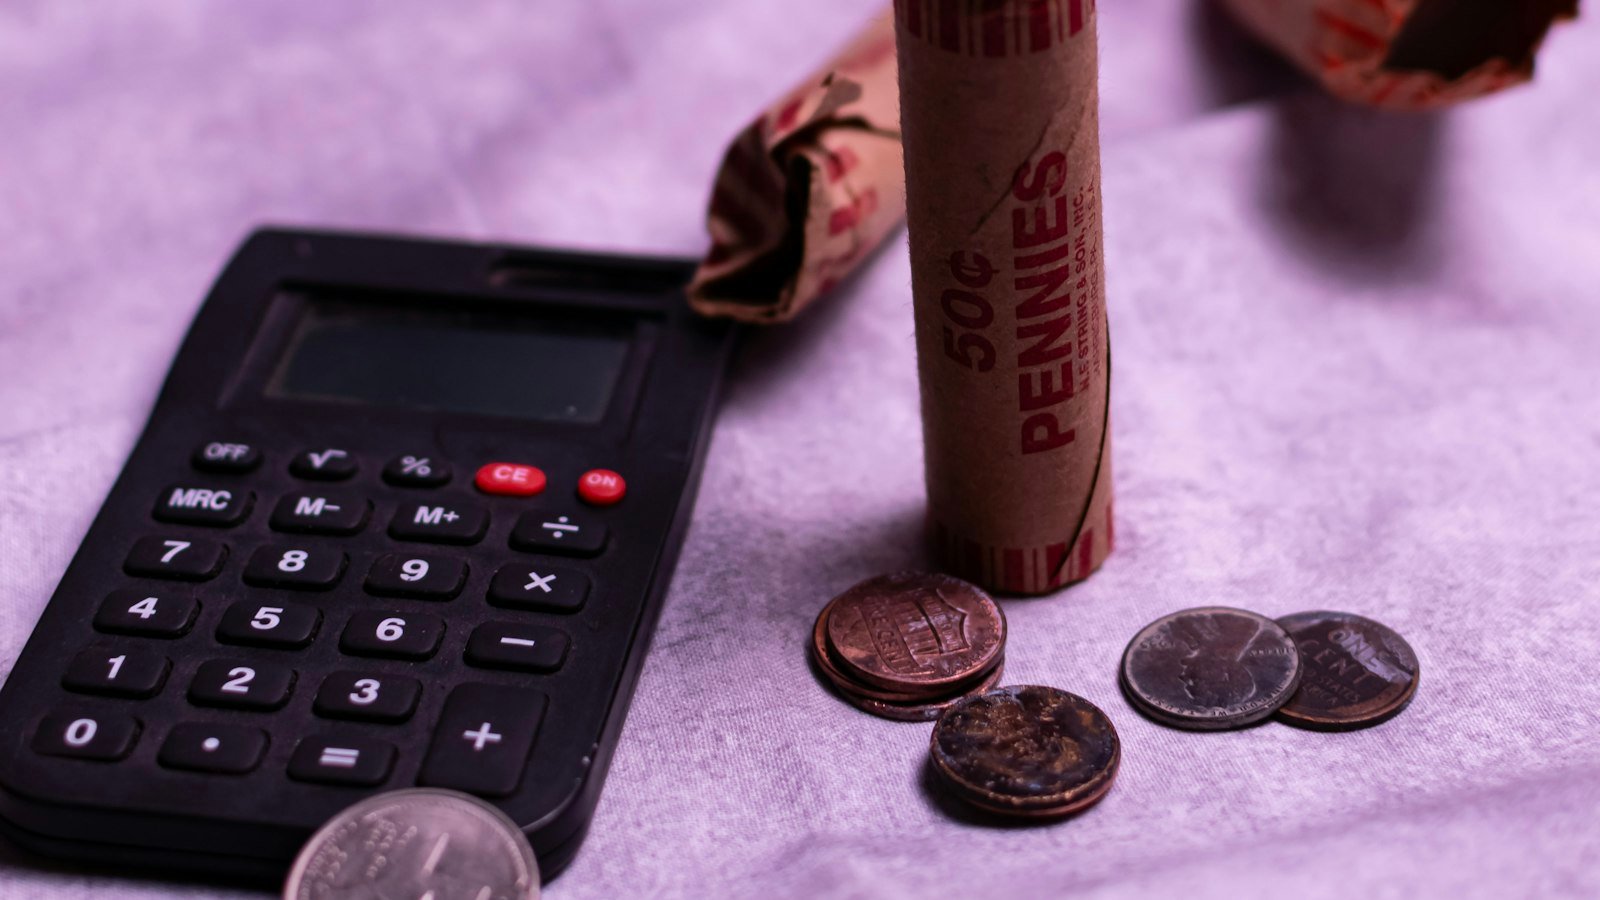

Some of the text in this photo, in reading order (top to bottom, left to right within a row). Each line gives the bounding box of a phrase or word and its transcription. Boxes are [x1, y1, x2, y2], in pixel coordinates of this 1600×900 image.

[1073, 186, 1084, 227] INC.
[1075, 227, 1086, 274] SON,
[1076, 275, 1087, 289] &
[941, 249, 999, 373] 50¢
[1012, 151, 1075, 455] PENNIES
[1077, 292, 1089, 359] STRING
[204, 442, 250, 460] OFF
[401, 455, 432, 476] %
[493, 465, 529, 483] CE
[587, 473, 617, 488] ON
[169, 488, 232, 511] MRC
[413, 505, 460, 524] M+
[161, 541, 190, 562] 7
[278, 550, 308, 571] 8
[400, 560, 428, 581] 9
[128, 598, 158, 618] 4
[251, 607, 283, 629] 5
[376, 618, 405, 641] 6
[108, 655, 125, 678] 1
[222, 667, 255, 692] 2
[350, 679, 380, 703] 3
[66, 719, 97, 744] 0
